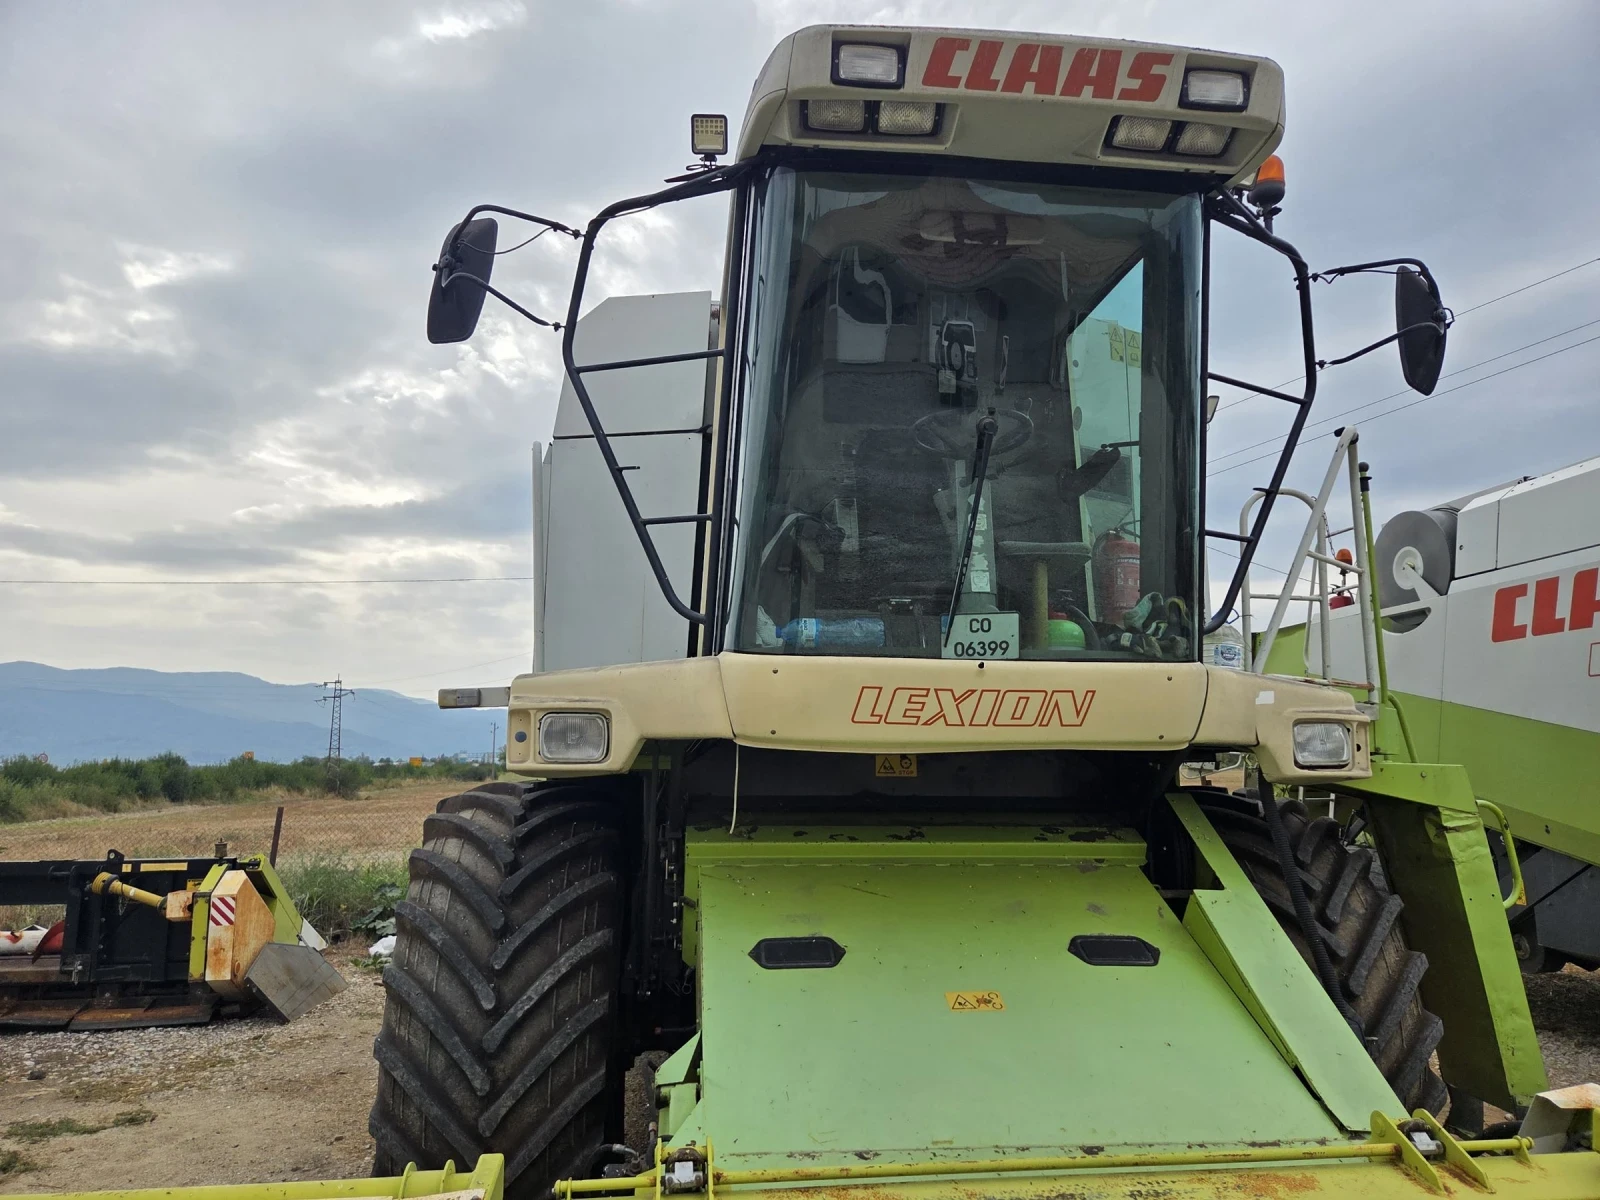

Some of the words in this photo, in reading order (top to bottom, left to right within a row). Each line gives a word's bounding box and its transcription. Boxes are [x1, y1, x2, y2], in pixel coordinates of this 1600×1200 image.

[921, 36, 1175, 103] CLAAS
[969, 617, 991, 633] CO
[954, 640, 1010, 657] 06399
[851, 685, 1097, 727] LEXION
